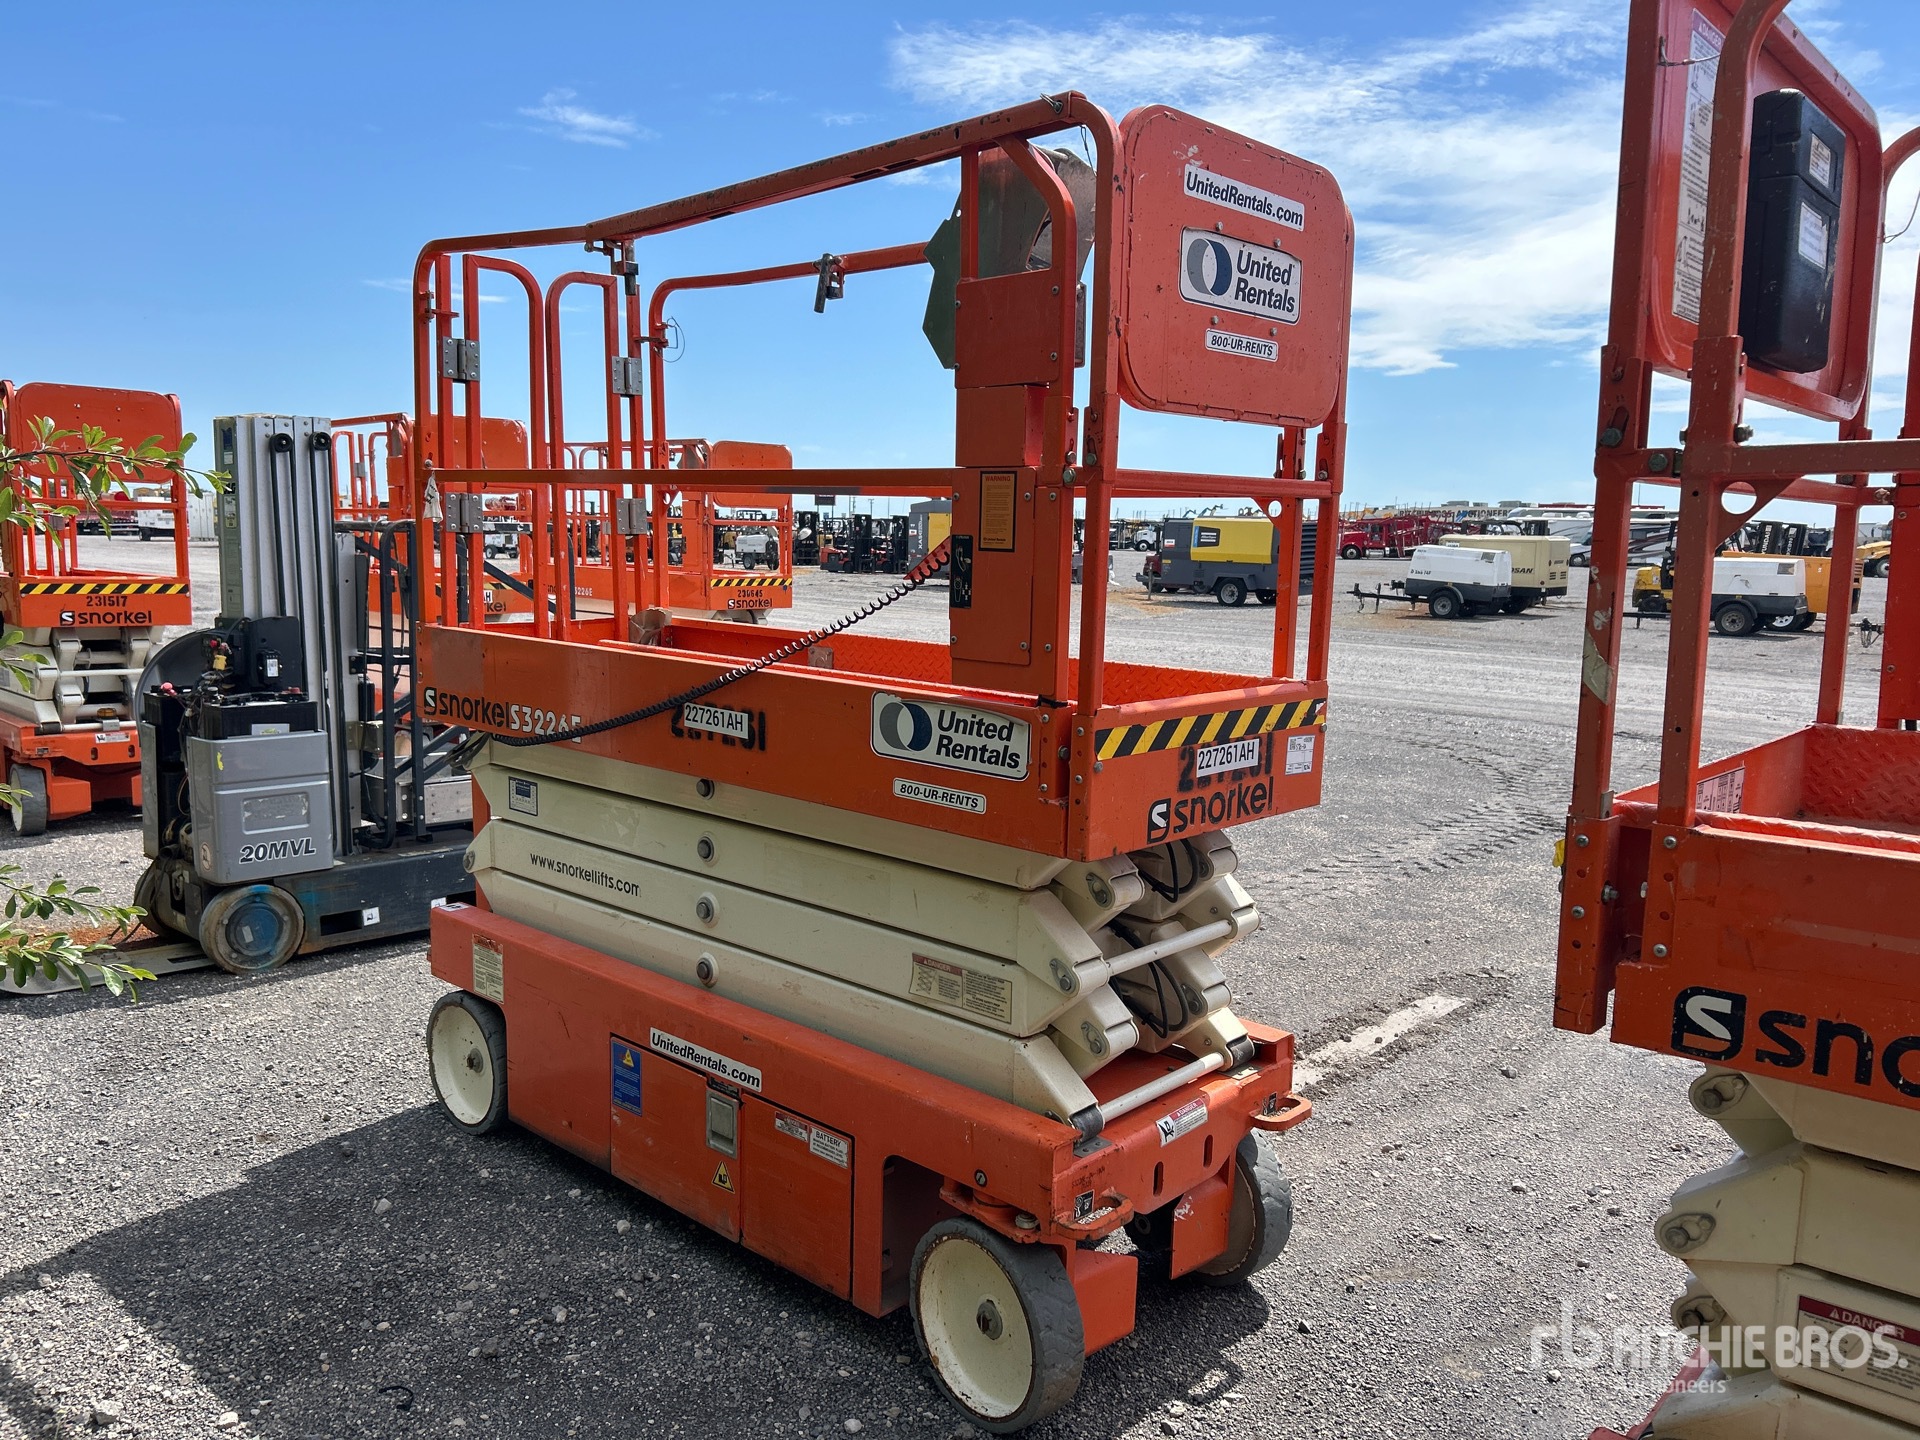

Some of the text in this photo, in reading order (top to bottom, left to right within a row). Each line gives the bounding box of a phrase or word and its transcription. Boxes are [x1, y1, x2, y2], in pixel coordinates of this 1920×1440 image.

[1186, 171, 1303, 227] UnitedRentals.com
[1236, 249, 1292, 286] United
[1234, 278, 1295, 313] Rentals
[1210, 335, 1274, 356] 800-UR-RENTS
[86, 595, 128, 607] 231517
[736, 598, 773, 609] snorkel
[78, 610, 152, 625] snorkel
[438, 691, 510, 730] snorkel
[685, 704, 743, 732] 227261AH
[937, 708, 1014, 743] United
[935, 735, 1020, 770] Rentals
[1198, 741, 1255, 771] 227261AH
[899, 783, 979, 809] 800-UR-RENTS
[1173, 776, 1274, 834] snorkel
[239, 837, 316, 864] 20MVL
[530, 852, 641, 898] www.snorkellifts.com
[651, 1032, 761, 1088] UnitedRentals.com
[815, 1130, 842, 1148] BATTERY
